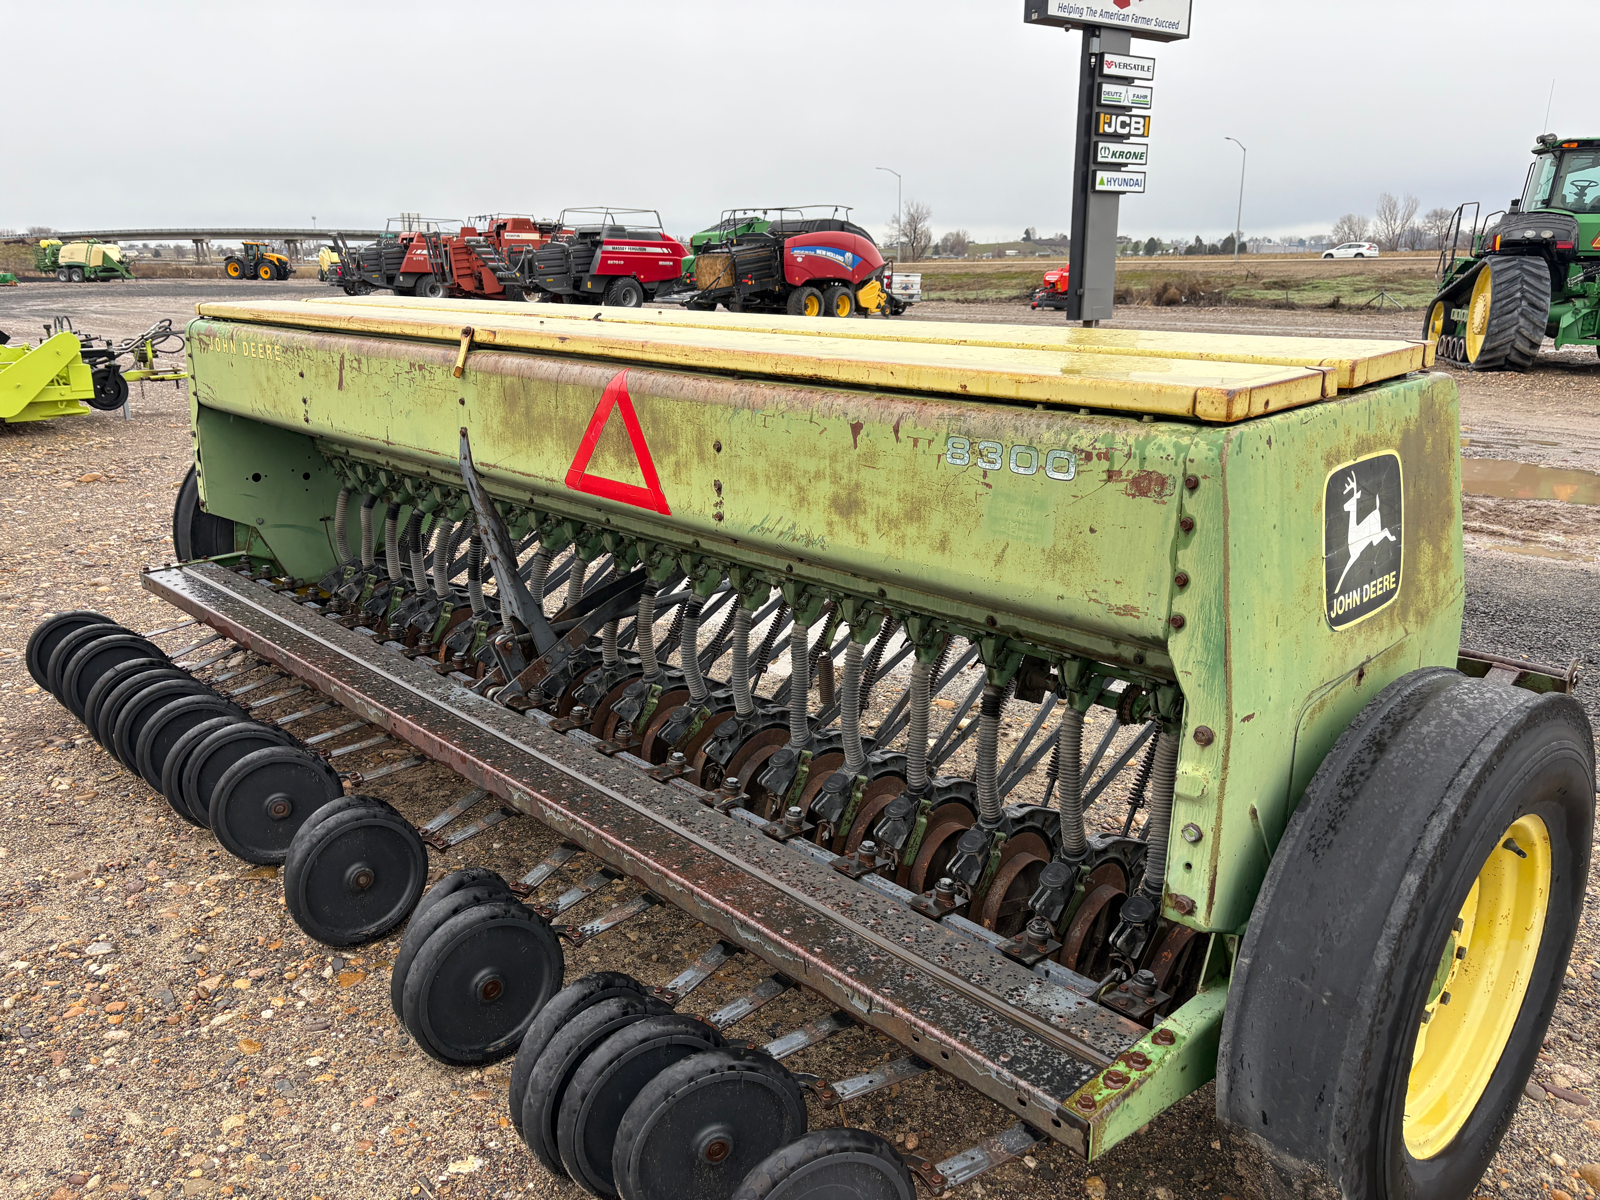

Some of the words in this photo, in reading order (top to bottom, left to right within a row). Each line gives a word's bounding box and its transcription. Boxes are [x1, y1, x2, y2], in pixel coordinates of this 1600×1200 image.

[1057, 2, 1084, 17] Helping
[1085, 6, 1098, 17] The
[1099, 9, 1130, 22] American
[1131, 13, 1154, 26] Farmer
[1154, 17, 1180, 30] Succeed
[1113, 61, 1152, 73] VERSATILE
[1103, 90, 1122, 98] DEUTZ
[1104, 116, 1144, 135] JCB
[1110, 150, 1145, 161] KRONE
[1106, 177, 1142, 188] HYUNDAI
[826, 250, 845, 262] HOLLAND
[209, 336, 237, 354] JOHN
[243, 341, 281, 361] DEERE
[945, 435, 1077, 482] 8300
[1330, 587, 1361, 619] JOHN
[1363, 571, 1397, 603] DEERE
